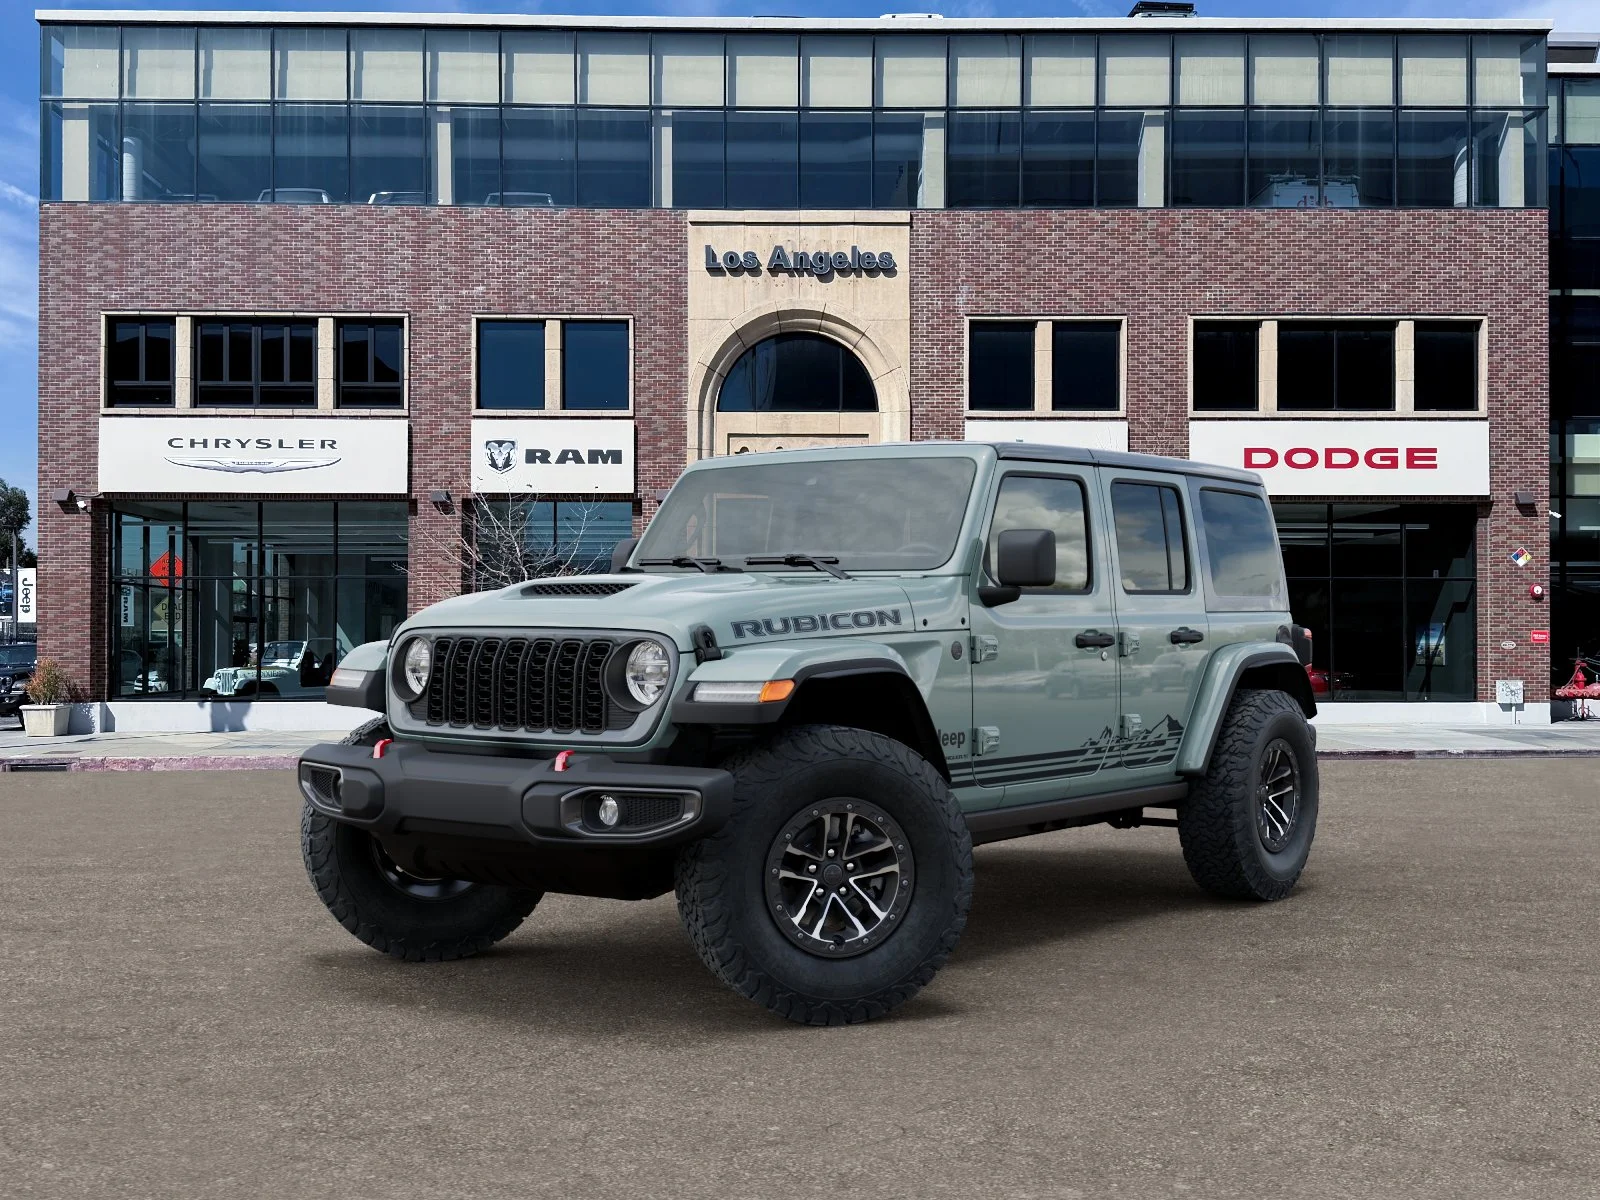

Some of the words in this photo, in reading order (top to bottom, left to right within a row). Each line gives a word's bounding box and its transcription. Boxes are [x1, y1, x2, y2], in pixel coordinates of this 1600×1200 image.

[704, 245, 759, 270] Los
[767, 245, 895, 276] Angeles
[167, 437, 338, 450] CHRYSLER
[525, 448, 623, 465] RAM
[1243, 447, 1438, 469] DODGE
[20, 577, 34, 613] Jeep
[164, 612, 181, 620] ED
[730, 608, 902, 639] RUBICON
